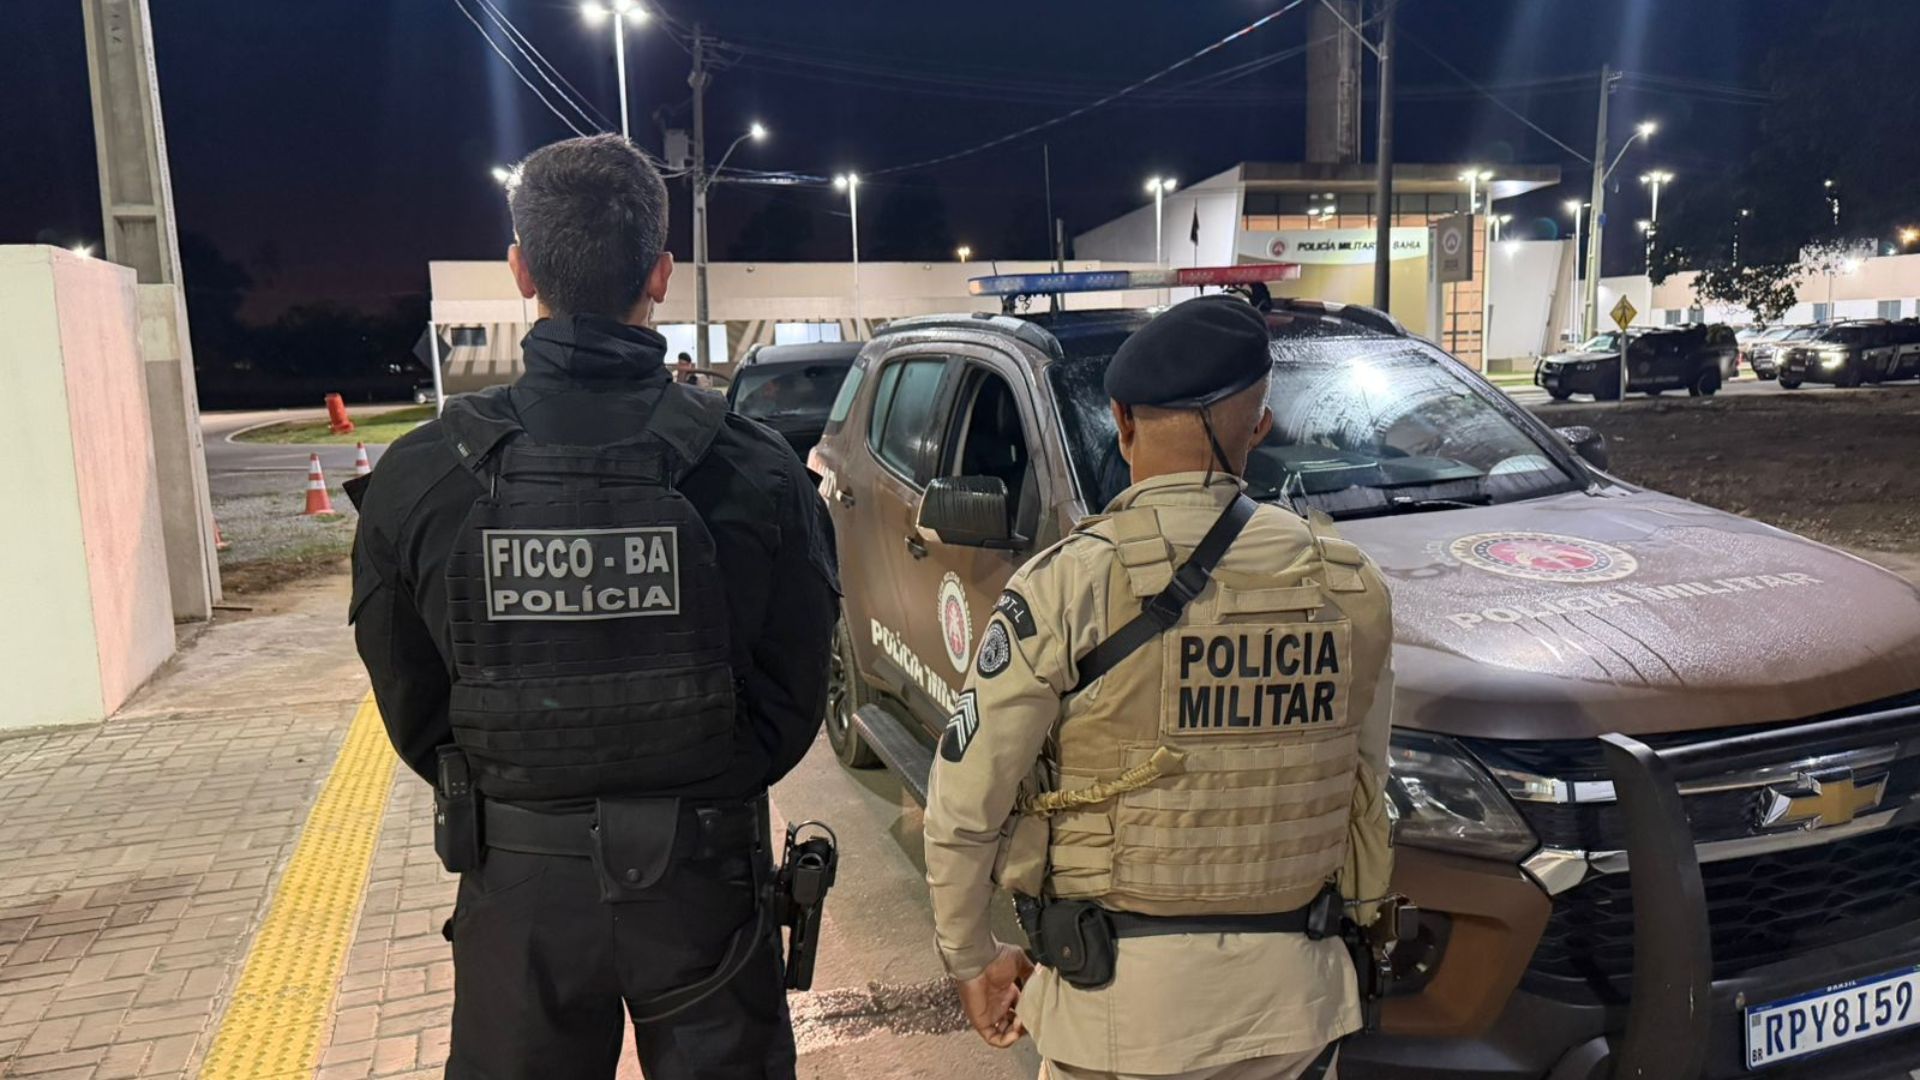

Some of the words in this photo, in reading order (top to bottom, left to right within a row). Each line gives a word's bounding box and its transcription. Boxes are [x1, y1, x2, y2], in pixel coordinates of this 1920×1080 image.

[491, 538, 594, 578] FICCO
[624, 535, 670, 575] BA
[493, 584, 673, 612] POLÍCIA
[1639, 572, 1825, 601] MILITAR
[870, 618, 924, 687] POLÍCIA
[1179, 628, 1340, 680] POLÍCIA
[1178, 681, 1336, 729] MILITAR
[1765, 980, 1913, 1056] RPY8I59
[1752, 1048, 1764, 1063] BR
